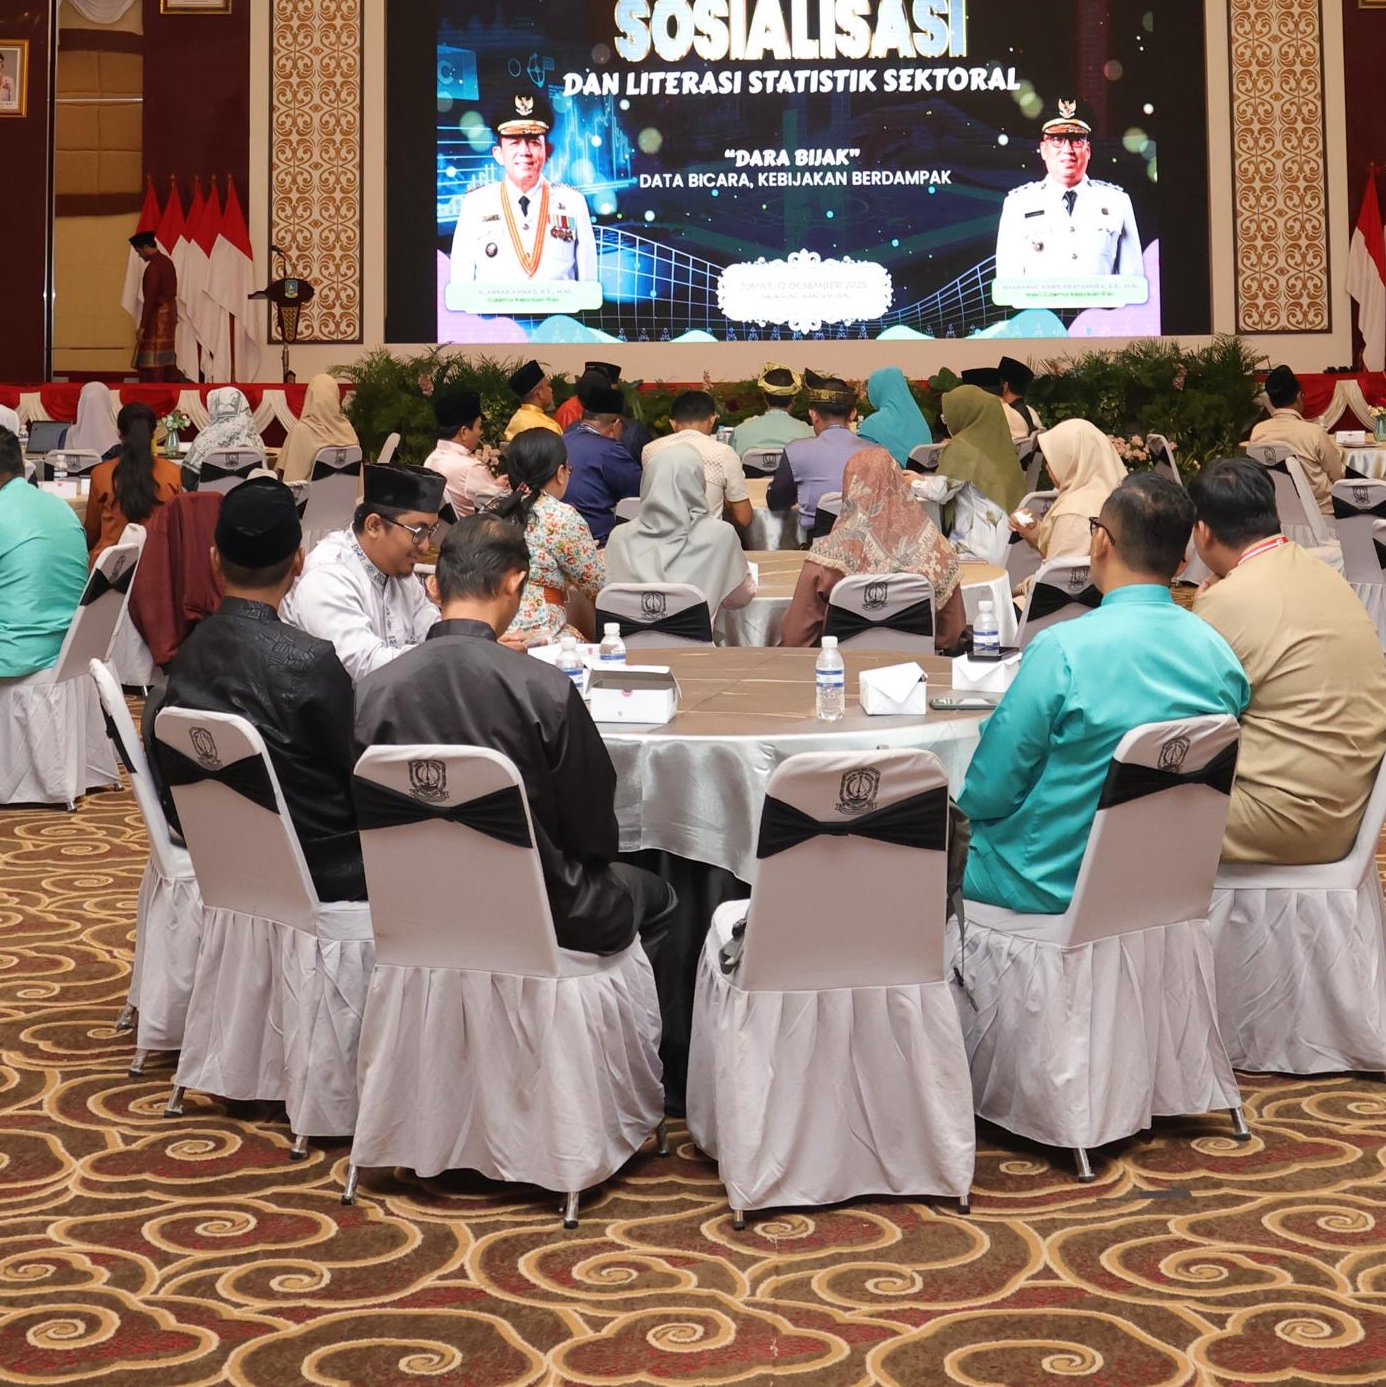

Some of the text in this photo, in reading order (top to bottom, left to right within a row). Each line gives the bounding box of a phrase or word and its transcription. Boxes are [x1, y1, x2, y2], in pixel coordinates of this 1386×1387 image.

[563, 66, 1021, 97] DAN LITERASI STATISTIK SEKTORAL
[639, 170, 952, 190] DATA BICARA, KEBIJAKAN BERDAMPAK
